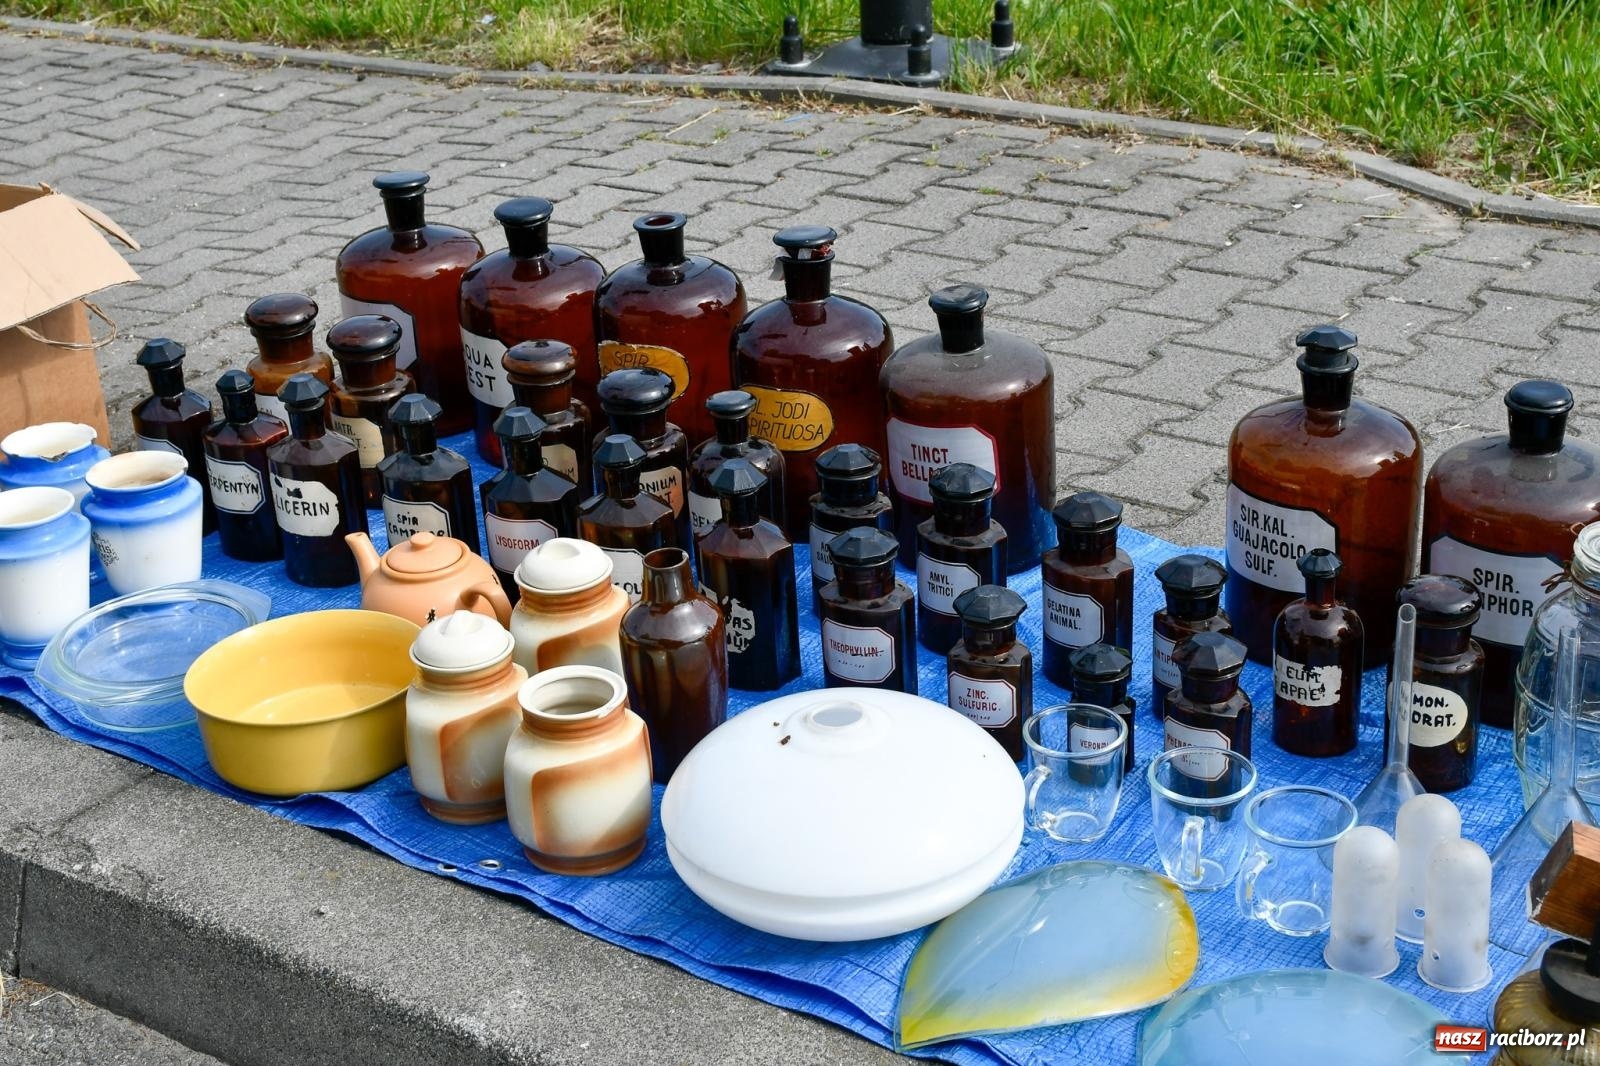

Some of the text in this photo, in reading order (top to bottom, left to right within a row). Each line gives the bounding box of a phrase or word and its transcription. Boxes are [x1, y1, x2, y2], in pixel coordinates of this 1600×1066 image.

[467, 365, 496, 392] EST
[771, 401, 811, 420] JODI
[749, 417, 825, 442] PIRITUOSA
[910, 443, 952, 465] TINCT.
[1232, 519, 1307, 561] GUAJACOLO
[1244, 550, 1277, 577] SULF.
[927, 580, 954, 598] TRITICI
[1472, 567, 1520, 594] SPIR.
[1047, 598, 1081, 618] GELATINA
[1480, 591, 1534, 618] PHOR
[958, 695, 1001, 712] SULFURIC.
[966, 687, 990, 700] ZINC.
